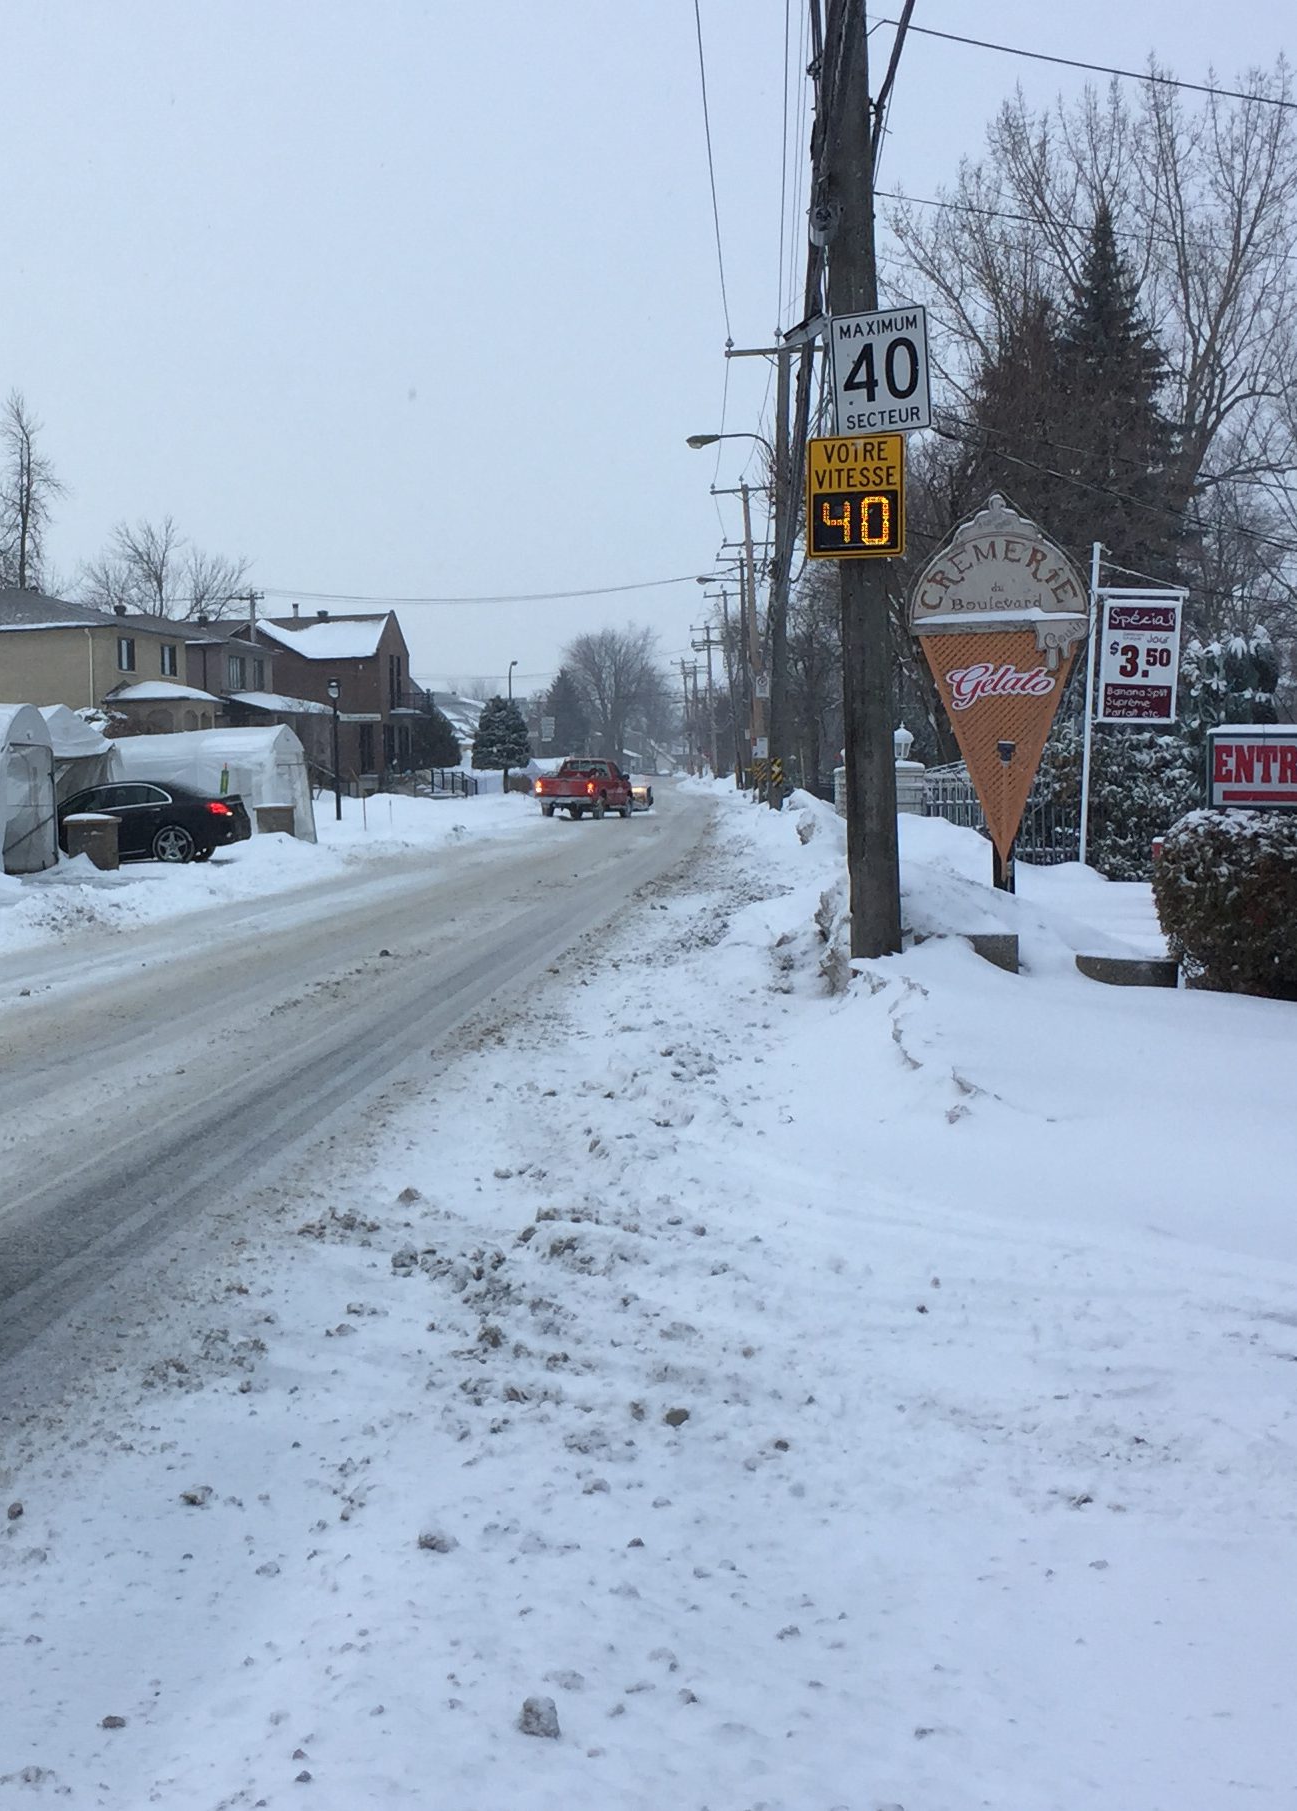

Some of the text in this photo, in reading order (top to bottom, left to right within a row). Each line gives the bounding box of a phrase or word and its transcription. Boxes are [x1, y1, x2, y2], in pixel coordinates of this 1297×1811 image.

[839, 315, 917, 339] MAXIMUM
[843, 337, 919, 402] 40
[847, 407, 920, 430] SECTEUR
[823, 442, 888, 465] VOTRE
[815, 466, 897, 490] VITESSE
[823, 495, 890, 544] 40
[991, 582, 1004, 593] du
[951, 593, 1042, 611] Boulevard
[1110, 608, 1174, 627] Spécial
[948, 664, 1053, 708] Gelato
[1106, 686, 1145, 697] Banana
[1214, 744, 1297, 784] ENTR
